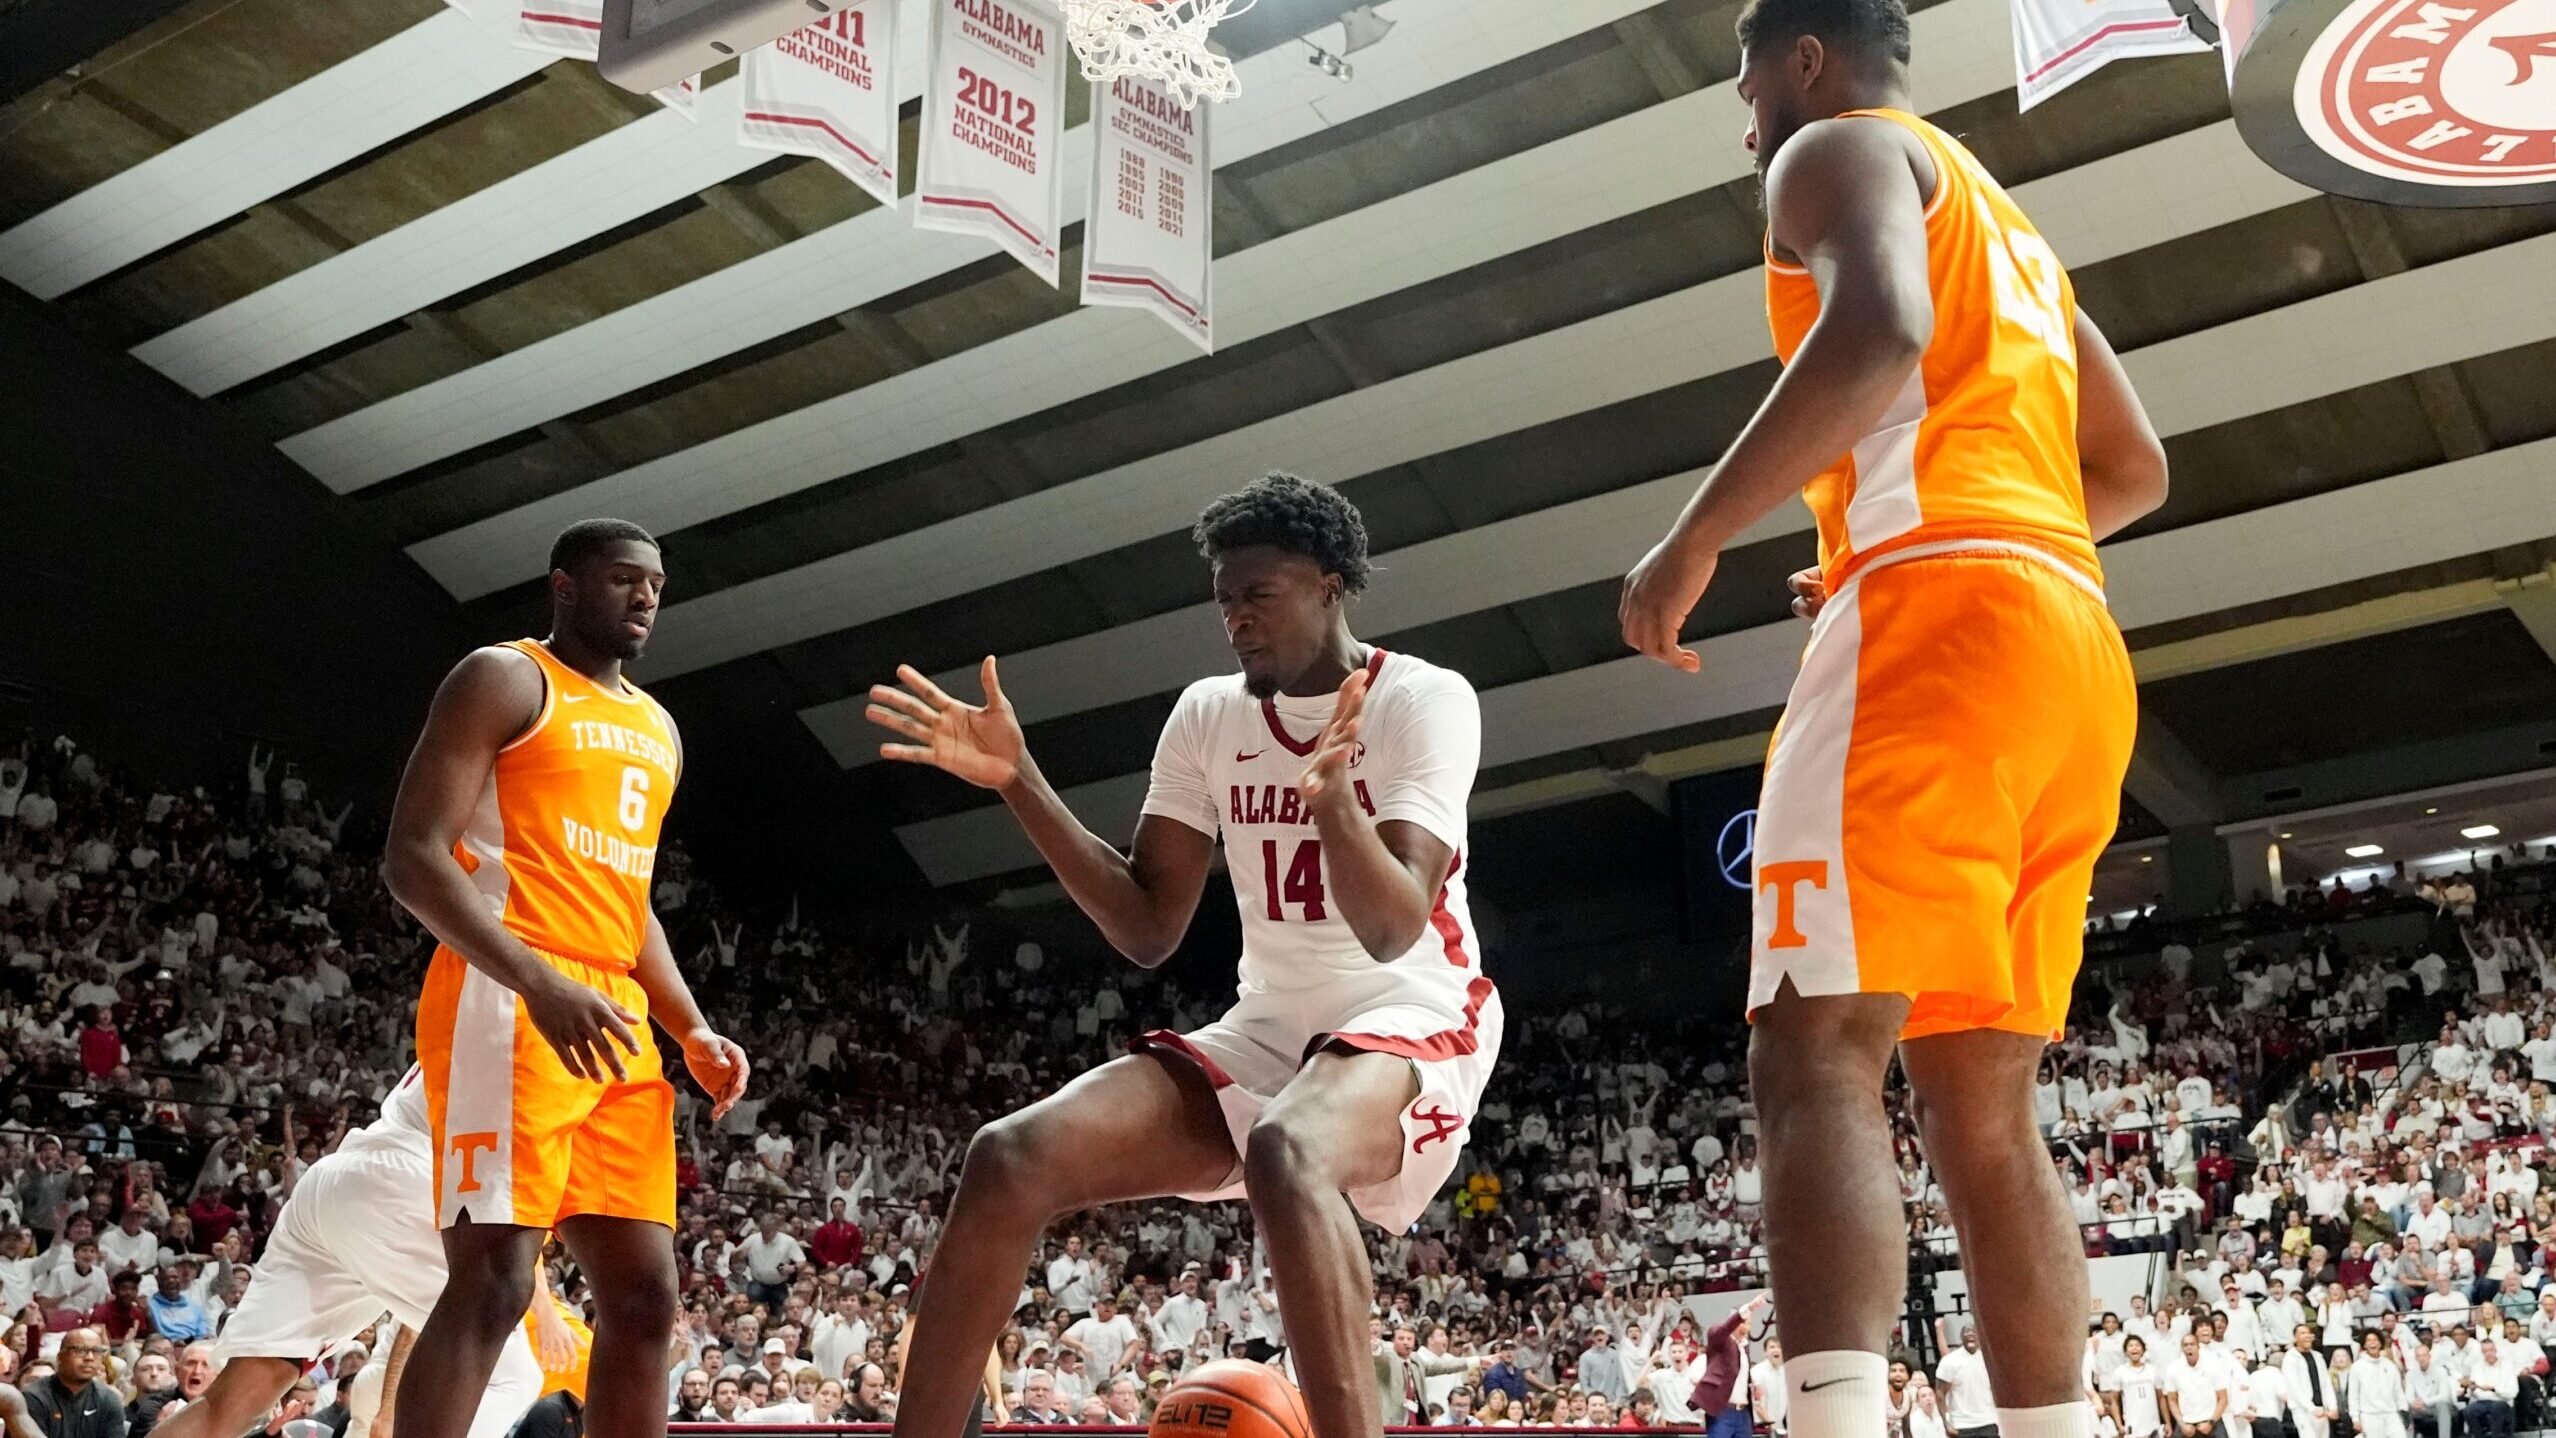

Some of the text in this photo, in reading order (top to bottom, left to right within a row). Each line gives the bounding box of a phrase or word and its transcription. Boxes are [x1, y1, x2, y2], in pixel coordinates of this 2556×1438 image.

[776, 36, 872, 91] CHAMPIONS
[791, 26, 872, 73] ATIONAL
[962, 21, 1036, 69] GYMNASTICS
[957, 66, 1036, 137] 2012
[1112, 75, 1194, 136] ALABAMA
[2365, 2, 2556, 161] LABAM
[952, 122, 1036, 175] CHAMPIONS
[954, 103, 1036, 158] NATIONAL
[1119, 107, 1185, 149] GYMNASTICS
[1132, 126, 1194, 165] CHAMPIONS
[619, 766, 649, 831] 6
[1230, 779, 1377, 825] ALABA
[1262, 839, 1327, 921] 14
[1759, 860, 1828, 949] T
[1411, 1096, 1465, 1154] A
[451, 1131, 498, 1193] T
[1157, 1403, 1233, 1429] ELITE
